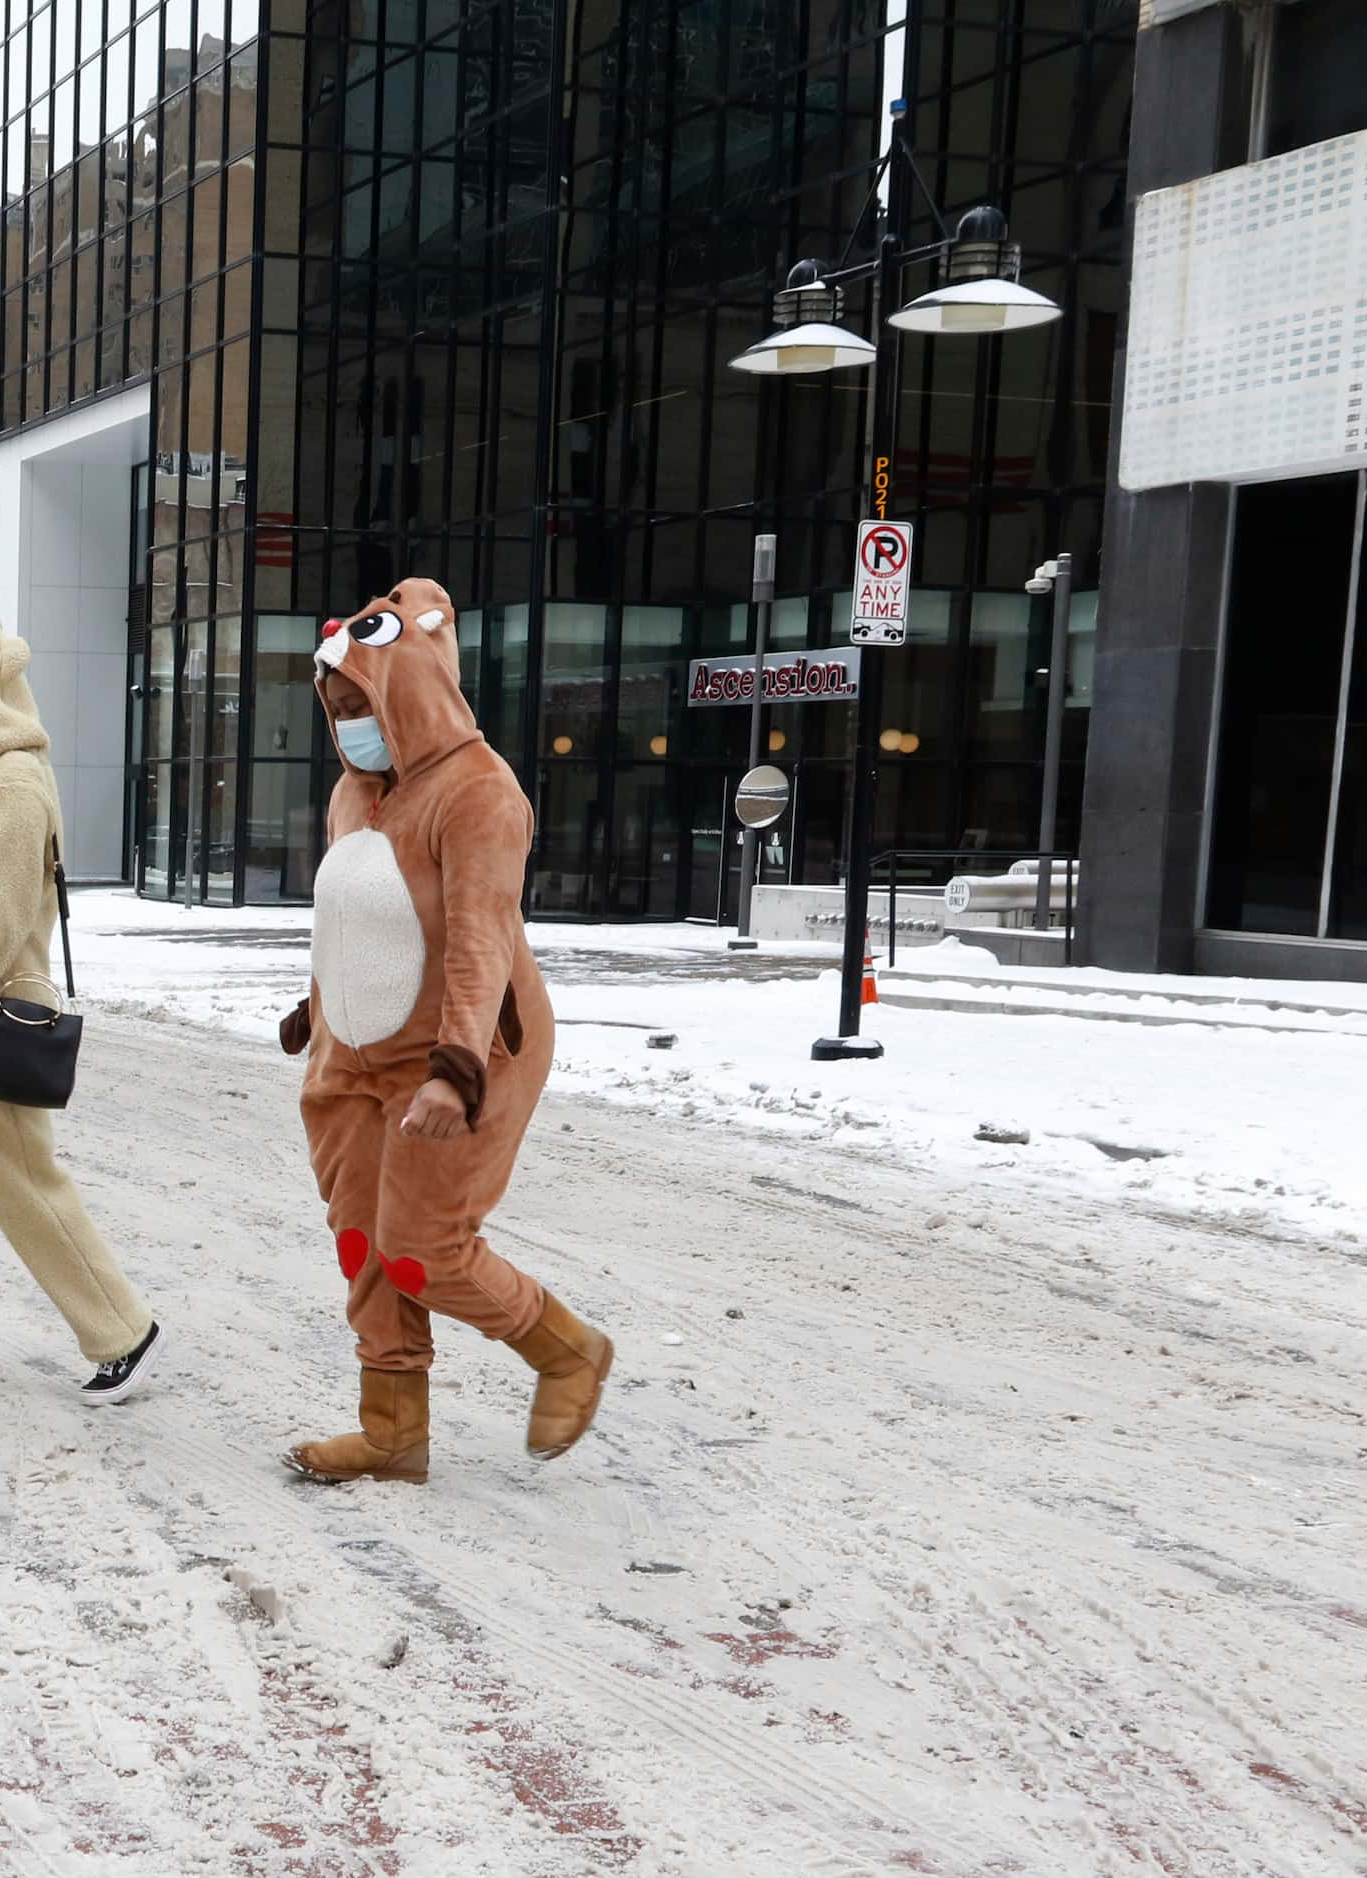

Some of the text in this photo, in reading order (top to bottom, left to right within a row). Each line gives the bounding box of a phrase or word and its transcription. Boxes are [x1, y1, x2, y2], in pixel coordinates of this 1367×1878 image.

[861, 584, 902, 601] ANY
[860, 601, 901, 618] TIME
[950, 885, 966, 895] EXIT
[949, 896, 965, 906] ONLY
